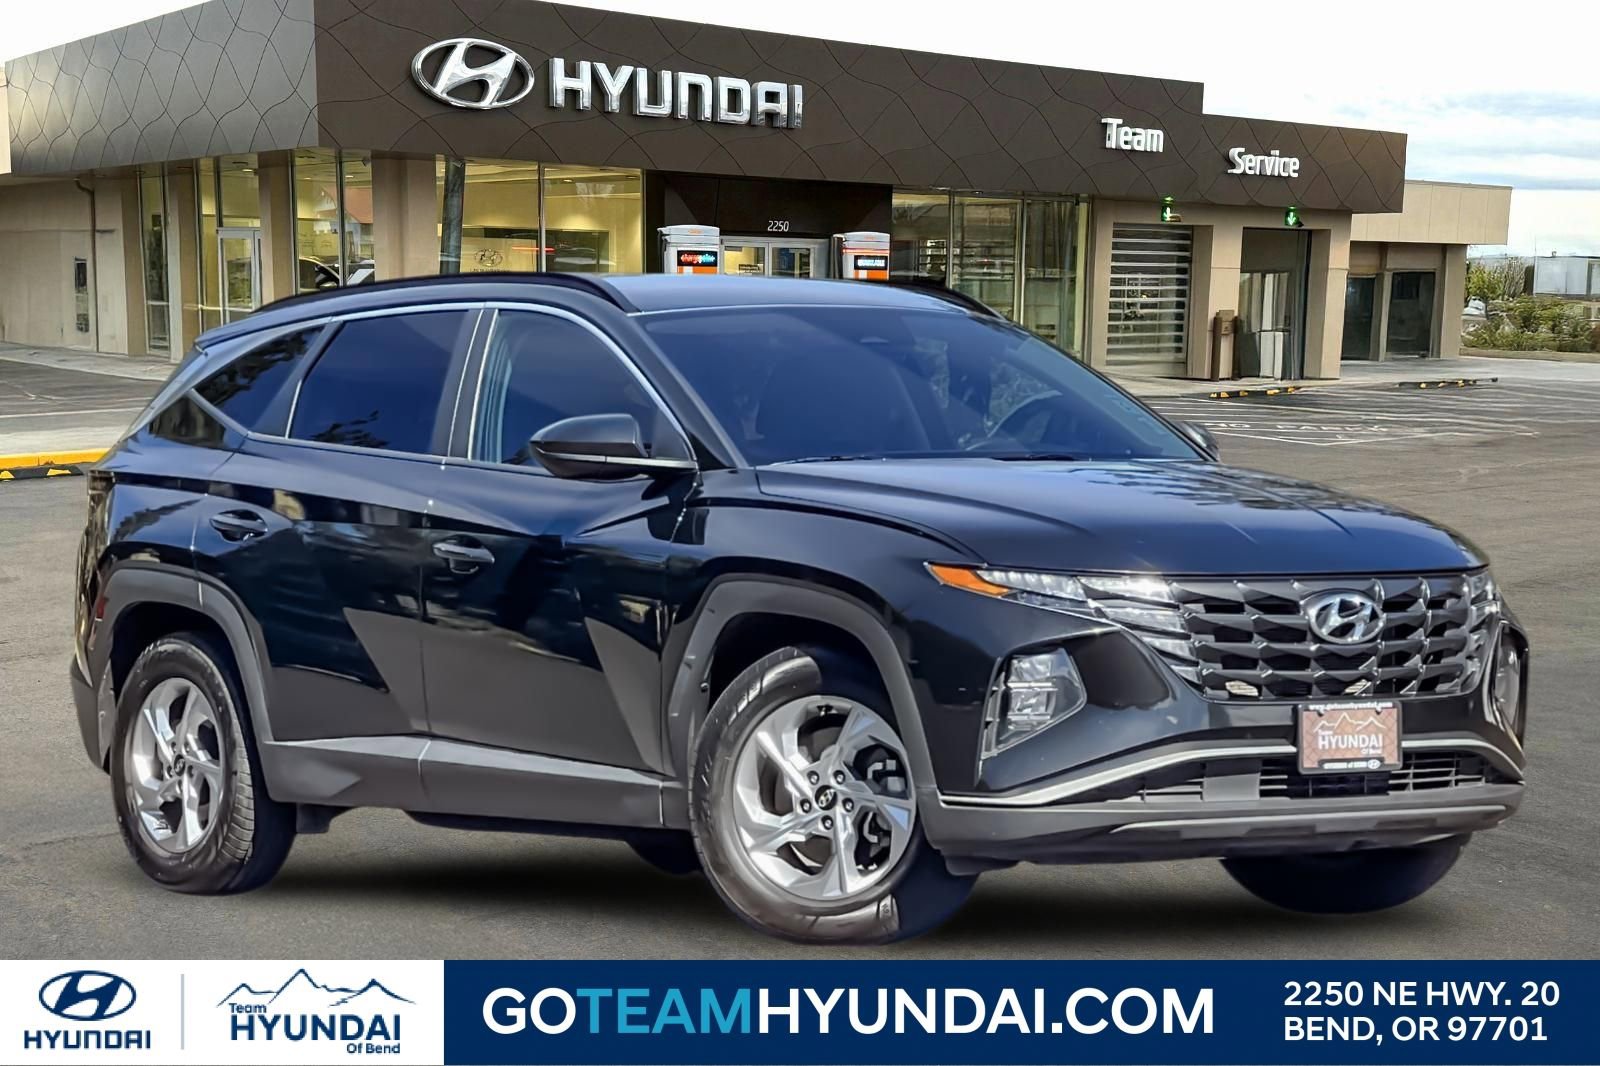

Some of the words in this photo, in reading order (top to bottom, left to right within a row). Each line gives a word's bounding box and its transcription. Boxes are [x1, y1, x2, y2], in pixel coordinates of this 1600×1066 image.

[549, 57, 803, 128] HYUNDAI
[1101, 117, 1164, 153] Team
[1227, 147, 1300, 178] Service
[767, 220, 790, 232] 2250
[1318, 733, 1383, 749] HYUNDAI
